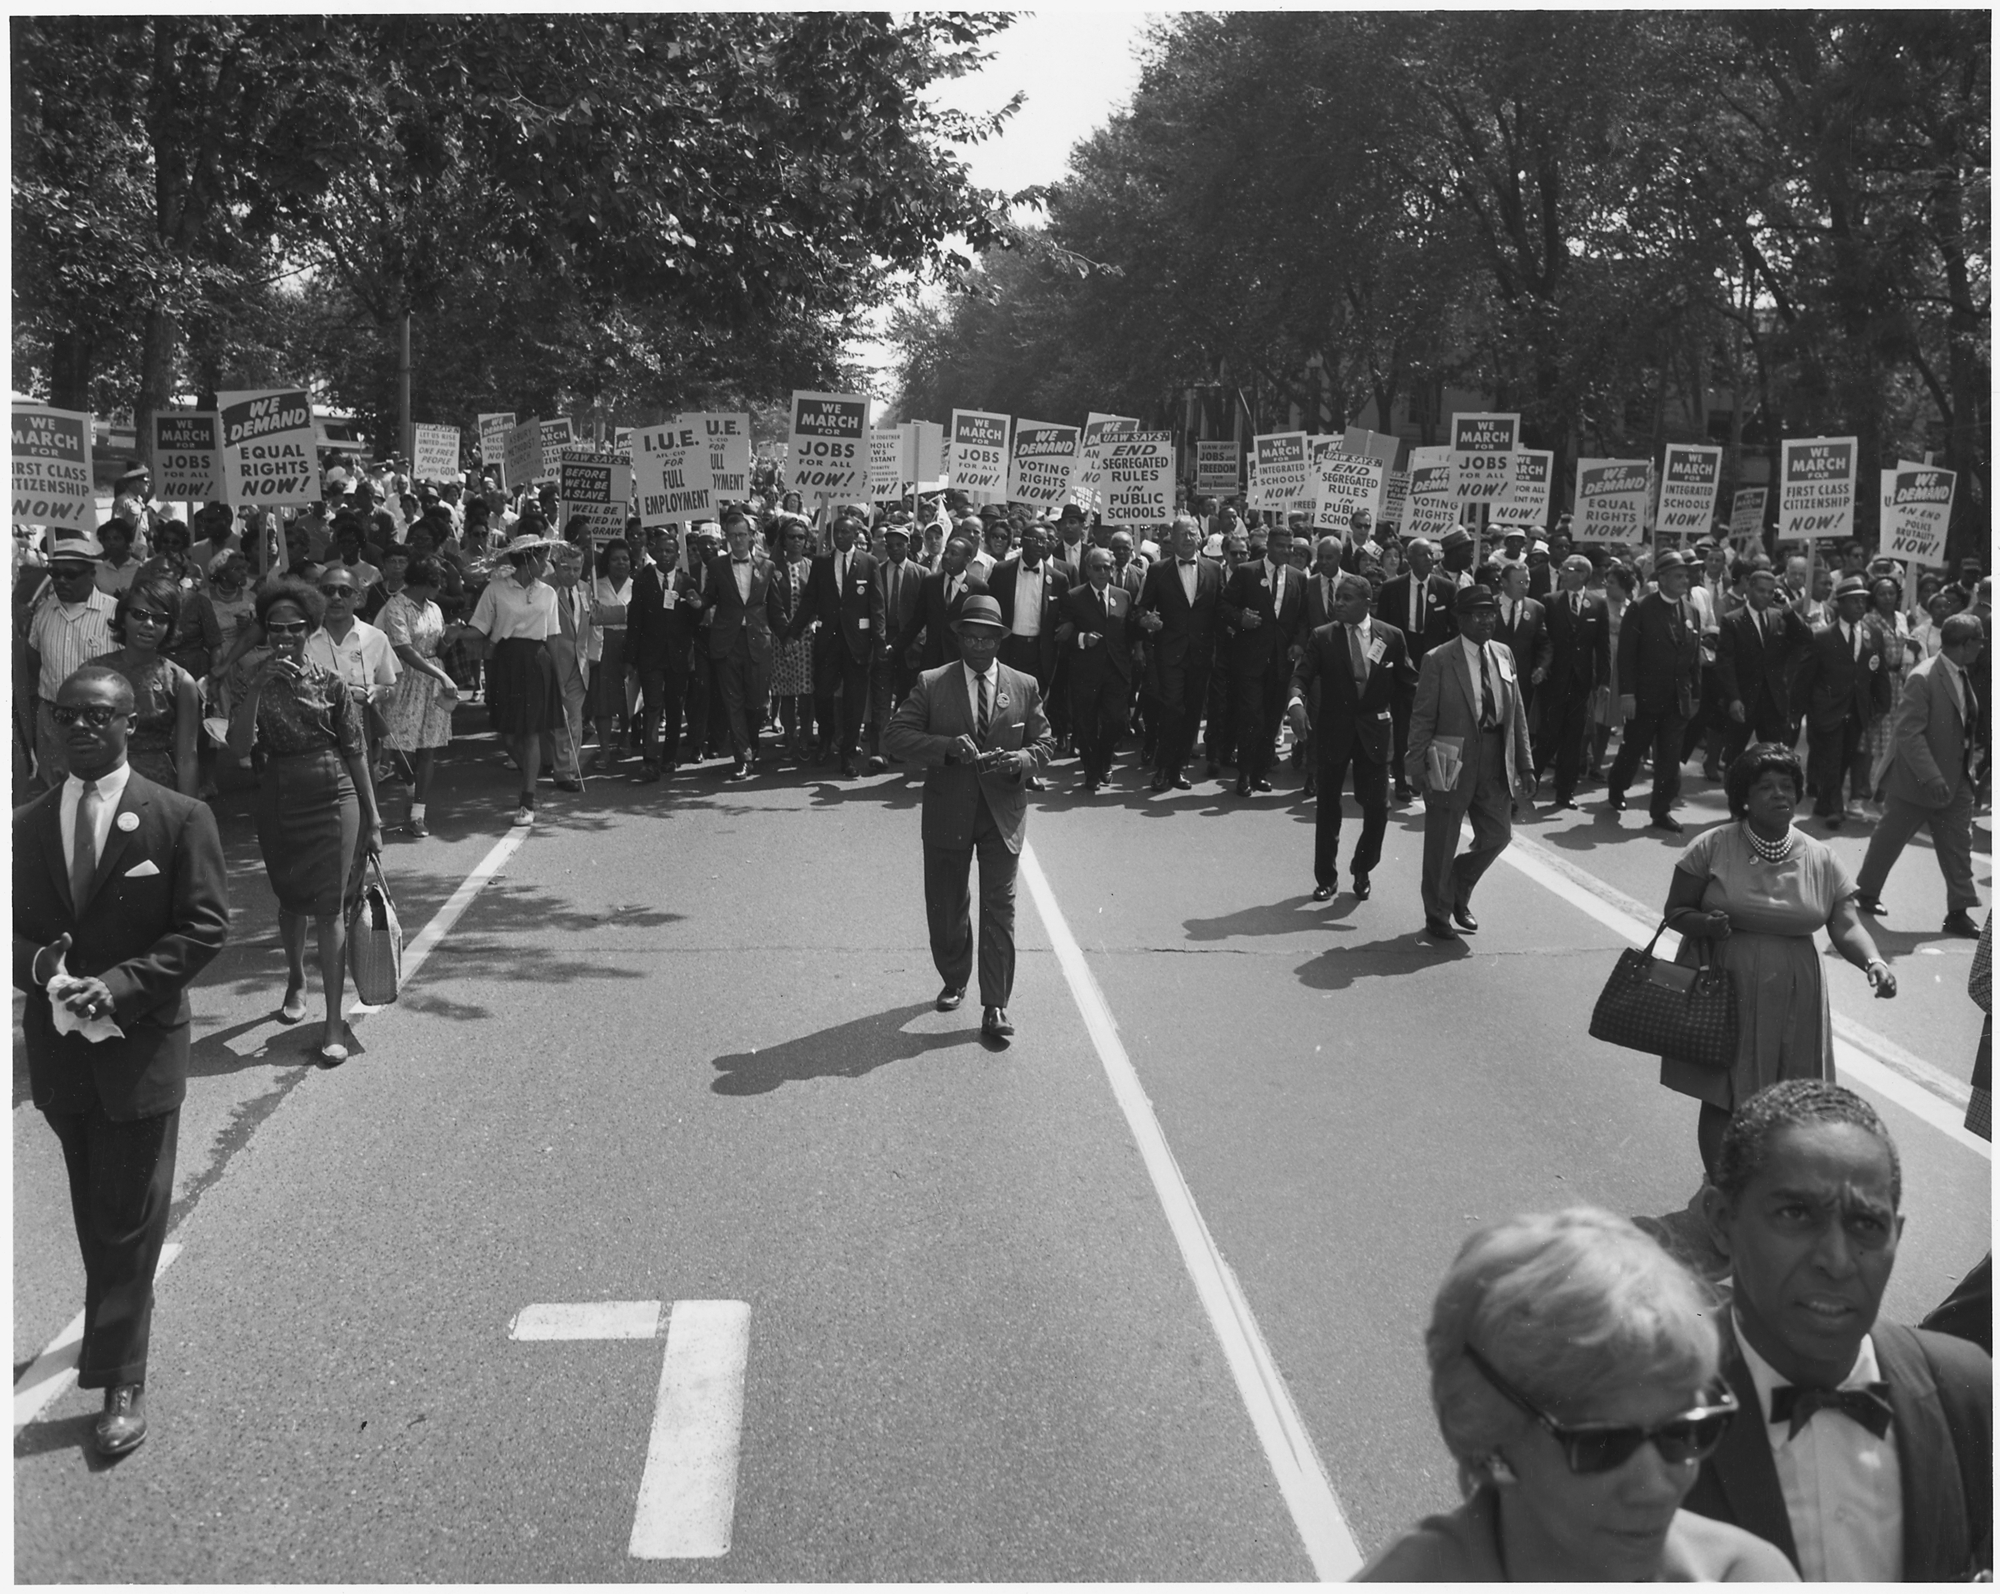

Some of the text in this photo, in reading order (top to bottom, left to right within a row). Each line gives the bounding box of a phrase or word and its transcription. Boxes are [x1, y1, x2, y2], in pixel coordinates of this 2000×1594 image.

[250, 397, 280, 418] WE
[822, 403, 842, 414] WE
[30, 417, 55, 430] WE
[176, 420, 192, 429] WE
[230, 408, 307, 441] DEMAND
[705, 420, 741, 435] U.E.
[801, 413, 859, 429] MARCH
[974, 418, 990, 428] WE
[1102, 421, 1122, 433] WE
[1477, 421, 1494, 430] WE
[161, 430, 209, 441] MARCH
[484, 422, 514, 436] DEMAND
[960, 426, 1002, 440] MARCH
[12, 430, 78, 450] MARCH
[541, 431, 567, 441] ARCH
[644, 430, 700, 452] I.U.E.
[1035, 430, 1059, 442] WE
[1103, 433, 1129, 442] UAW
[1131, 432, 1169, 442] SAYS:
[1460, 431, 1509, 442] MARCH
[709, 443, 726, 451] FOR
[798, 441, 855, 458] JOBS
[1018, 441, 1074, 456] DEMAND
[1272, 439, 1287, 447] WE
[31, 447, 59, 457] FOR
[240, 444, 305, 460] EQUAL
[436, 449, 455, 457] FREE
[958, 449, 999, 463] JOBS
[1112, 444, 1158, 457] END
[1200, 451, 1225, 461] JOBS
[1261, 445, 1300, 458] MARCH
[1326, 452, 1348, 461] UAW
[1810, 447, 1830, 458] WE
[162, 455, 210, 469] JOBS
[421, 455, 452, 465] PEOPLE
[564, 452, 591, 463] UAW
[591, 455, 627, 465] SAYS:
[664, 457, 684, 467] FOR
[710, 453, 725, 470] ULL
[799, 458, 824, 466] FOR
[1102, 456, 1169, 470] SEGREGATED
[1458, 456, 1507, 470] JOBS
[1517, 456, 1531, 464] WE
[1688, 453, 1702, 463] WE
[1792, 457, 1846, 472] MARCH
[47, 464, 87, 482] CLASS
[240, 460, 309, 477] RIGHTS
[440, 466, 456, 476] GOD
[565, 468, 607, 479] BEFORE
[1018, 459, 1070, 476] VOTING
[1200, 463, 1236, 473] FREEDOM
[1259, 463, 1305, 475] INTEGRATED
[1331, 463, 1370, 476] END
[1602, 467, 1628, 480] WE
[1672, 462, 1713, 475] MARCH
[663, 469, 685, 490] FULL
[795, 470, 855, 487] NOW!
[956, 472, 1000, 487] NOW!
[1020, 472, 1066, 488] RIGHTS
[1111, 470, 1159, 482] RULES
[1260, 474, 1306, 486] SCHOOLS
[1322, 472, 1378, 488] SEGREGATED
[1807, 471, 1829, 479] FOR
[1914, 473, 1938, 487] WE
[164, 481, 213, 496] NOW!
[241, 476, 311, 497] NOW!
[565, 478, 608, 490] WE'LL BE
[1413, 479, 1449, 492] DEMA
[1457, 481, 1508, 496] NOW!
[1584, 477, 1645, 495] DEMAND
[1665, 484, 1713, 496] INTEGRATED
[1787, 483, 1850, 498] FIRST CLASS
[563, 489, 570, 498] A
[1016, 484, 1066, 501] NOW!
[1264, 484, 1304, 499] NOW!
[1328, 484, 1369, 498] RULES
[1896, 485, 1950, 502] DEMAND
[644, 489, 709, 515] EMPLOYMENT
[1110, 492, 1164, 505] PUBLIC
[1413, 496, 1458, 510] VOTING
[1530, 496, 1544, 504] PAY
[1589, 498, 1635, 511] EQUAL
[1663, 498, 1710, 509] SCHOOLS
[1783, 496, 1850, 510] CITIZENSHIP
[12, 499, 85, 520] NOW!
[572, 503, 618, 515] WE'LL BE
[1107, 506, 1166, 519] SCHOOLS
[1412, 508, 1454, 521] RIGHTS
[1497, 507, 1541, 519] NOW!
[1898, 505, 1941, 520] AN END
[610, 518, 622, 526] IN
[1320, 513, 1349, 526] SCHO
[1586, 510, 1636, 523] RIGHTS
[1664, 512, 1707, 526] NOW!
[1789, 512, 1845, 531] NOW!
[592, 526, 622, 536] GRAVE
[1409, 520, 1453, 534] NOW!
[1584, 524, 1637, 537] NOW!
[1905, 519, 1931, 531] POLICE
[1896, 527, 1935, 541] BRUTALITY
[1891, 537, 1940, 556] NOW!
